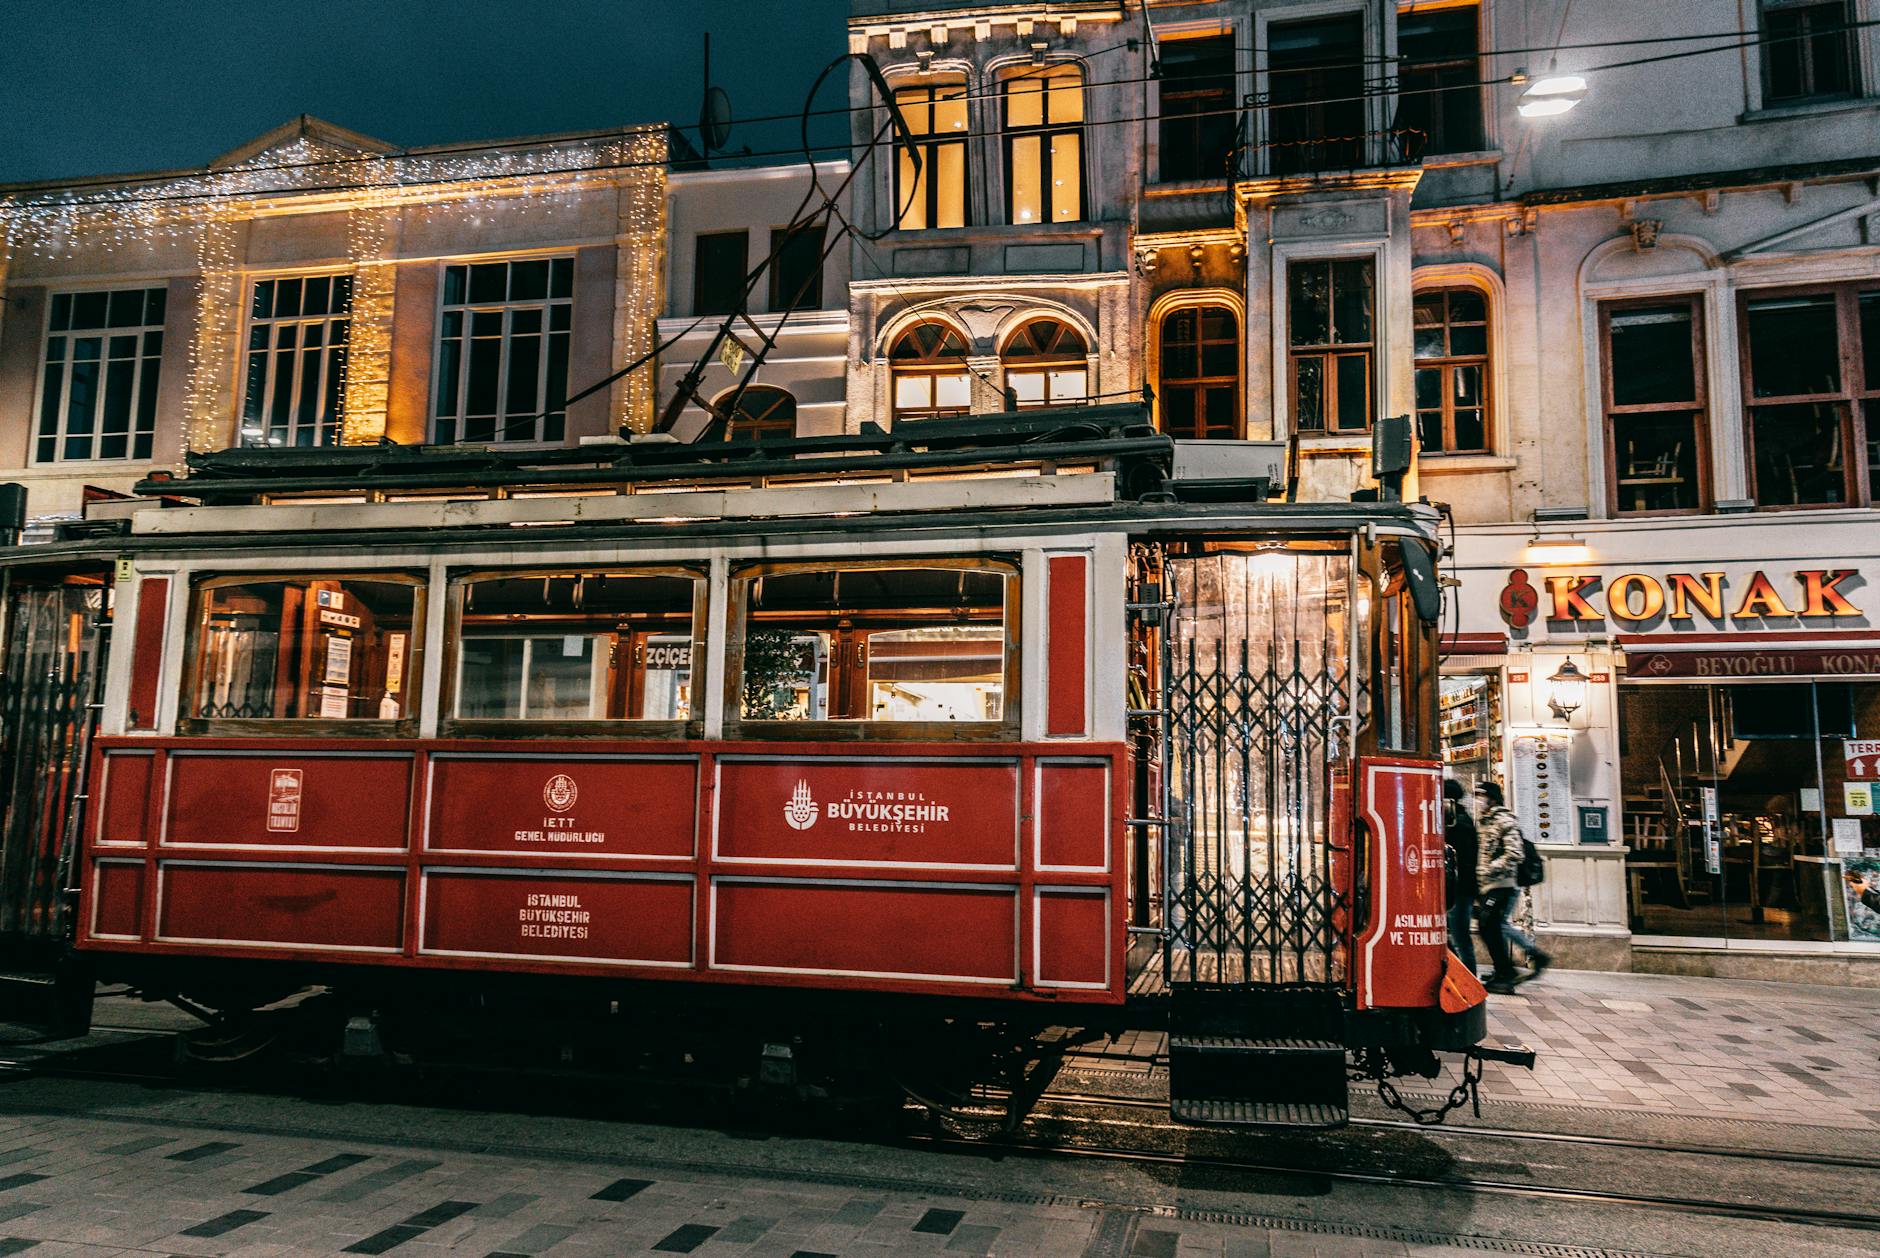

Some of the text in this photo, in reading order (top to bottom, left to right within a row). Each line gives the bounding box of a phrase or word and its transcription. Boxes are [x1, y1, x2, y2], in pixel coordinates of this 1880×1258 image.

[1545, 569, 1863, 621] KONAK
[1695, 652, 1795, 676] BEYOĞLU
[849, 789, 925, 801] İSTANBUL
[827, 799, 949, 825] BÜYÜKŞEHİR
[514, 830, 546, 841] GENEL
[849, 823, 925, 833] BELEDİYESİ
[527, 893, 581, 908] İSTANBUL
[519, 909, 590, 925] BÜYÜKŞEHİR
[1394, 914, 1433, 928] ASILMAK
[521, 924, 588, 939] BELEDİYESİ
[1390, 931, 1404, 945] VE
